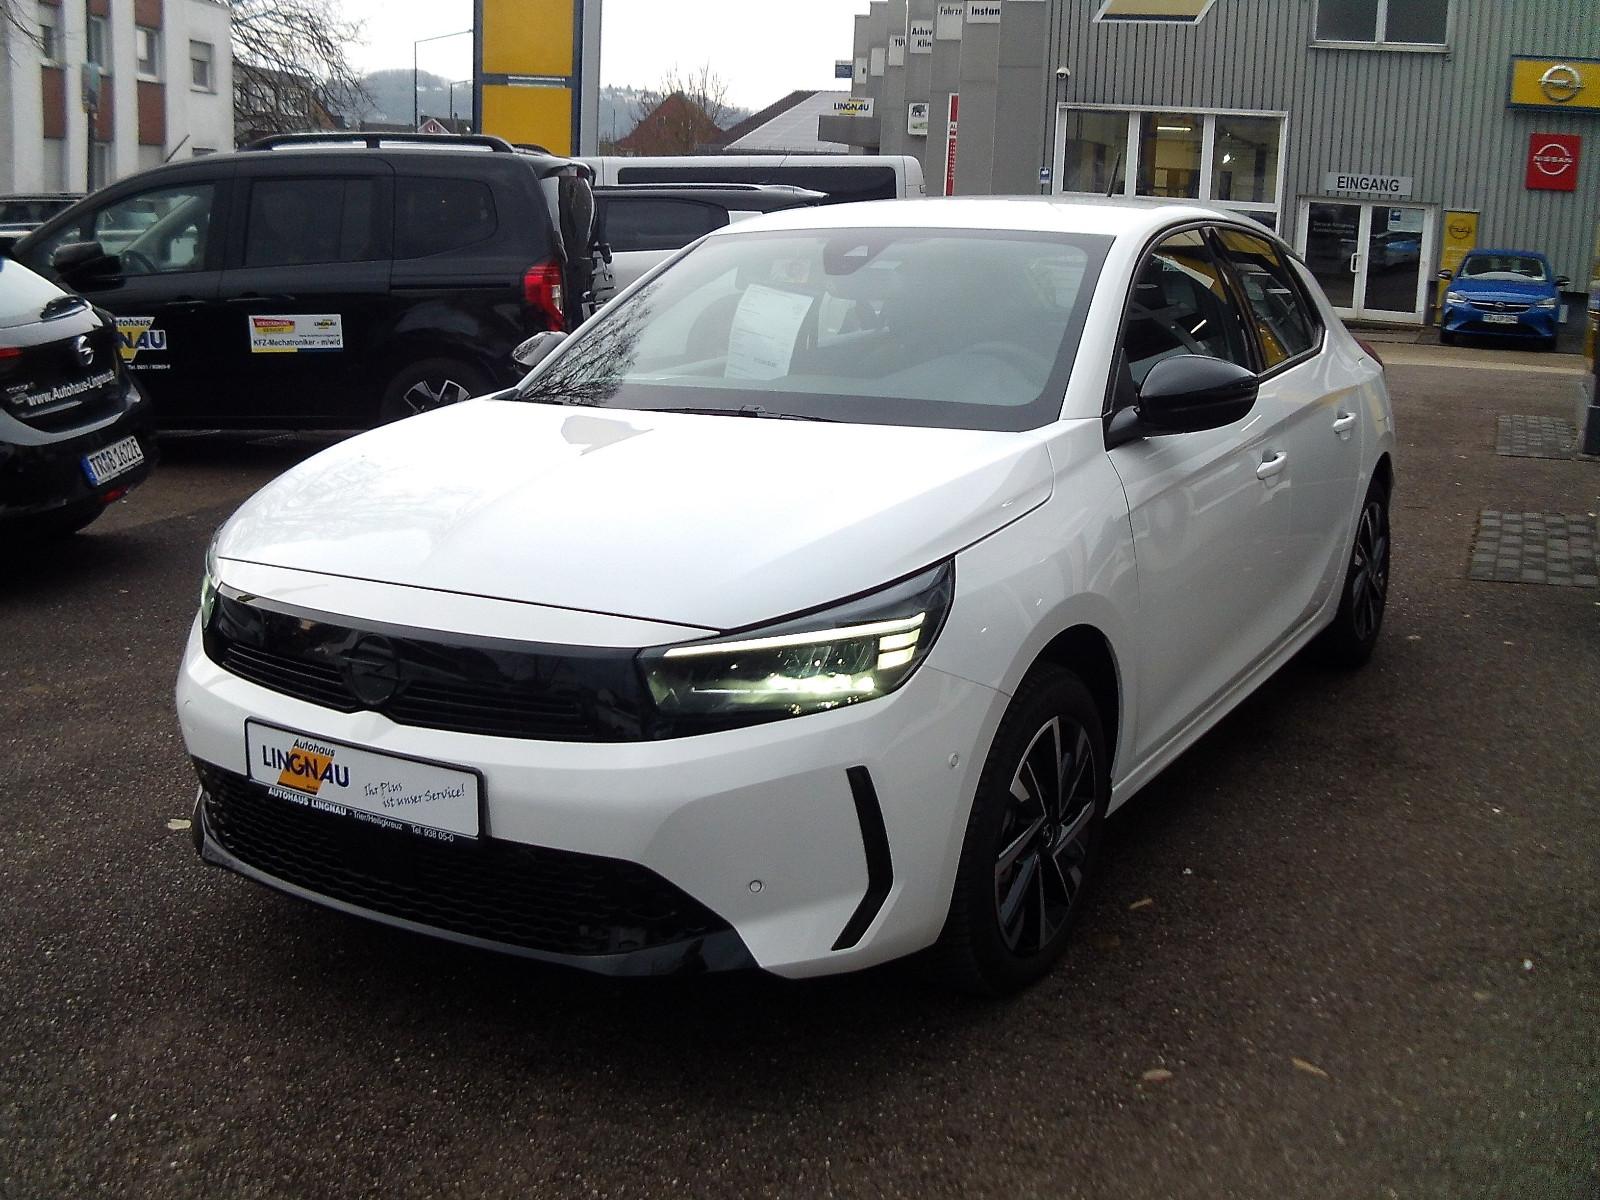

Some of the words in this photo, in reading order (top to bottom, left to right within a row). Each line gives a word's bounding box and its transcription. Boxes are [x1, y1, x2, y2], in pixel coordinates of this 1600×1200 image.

[833, 102, 869, 111] LINGNAU
[1532, 155, 1573, 163] NISSAN
[1337, 176, 1400, 192] EINGANG
[253, 338, 315, 347] KFZ-Mechatroniker
[293, 738, 336, 757] Autohaus
[262, 744, 350, 788] LINGNAU
[364, 783, 379, 797] Ihr
[379, 781, 403, 797] Plus
[382, 795, 396, 808] ist
[396, 793, 423, 806] unser
[424, 782, 466, 802] Service!
[267, 786, 309, 806] AUTOHAUS
[311, 798, 347, 816] LINGNAU
[411, 823, 422, 835] Tel.
[423, 827, 437, 839] 938
[438, 831, 455, 843] 05-0
